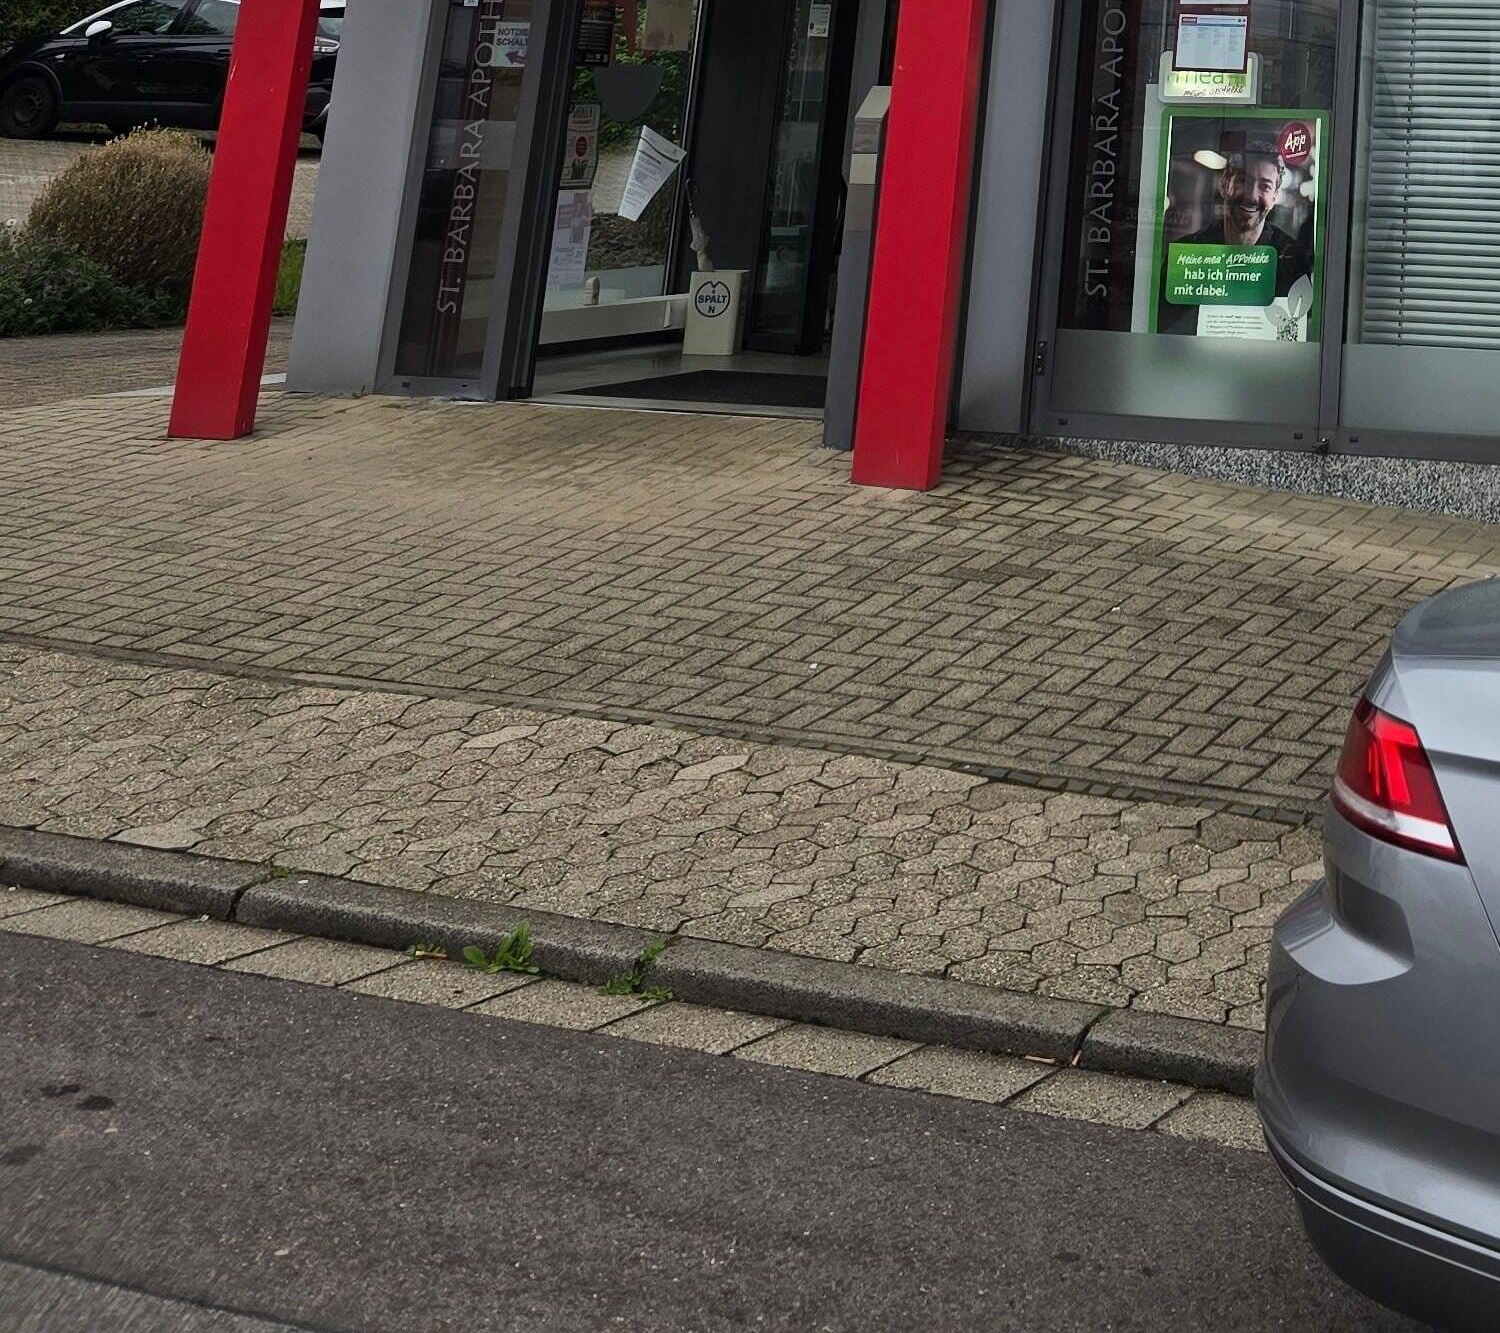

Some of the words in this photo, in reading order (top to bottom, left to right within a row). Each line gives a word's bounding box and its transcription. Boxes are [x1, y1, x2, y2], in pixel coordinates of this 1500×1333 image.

[1284, 132, 1306, 153] App
[1087, 88, 1121, 244] BARBARA
[443, 117, 486, 263] BARBARA
[1176, 253, 1203, 266] Meine
[1084, 257, 1110, 297] ST.
[1184, 268, 1206, 280] hab
[1207, 268, 1223, 281] ich
[1225, 269, 1262, 282] immer
[437, 277, 462, 314] ST.
[697, 294, 728, 304] SPALT
[1173, 284, 1193, 295] mit
[1195, 284, 1229, 297] dabei.
